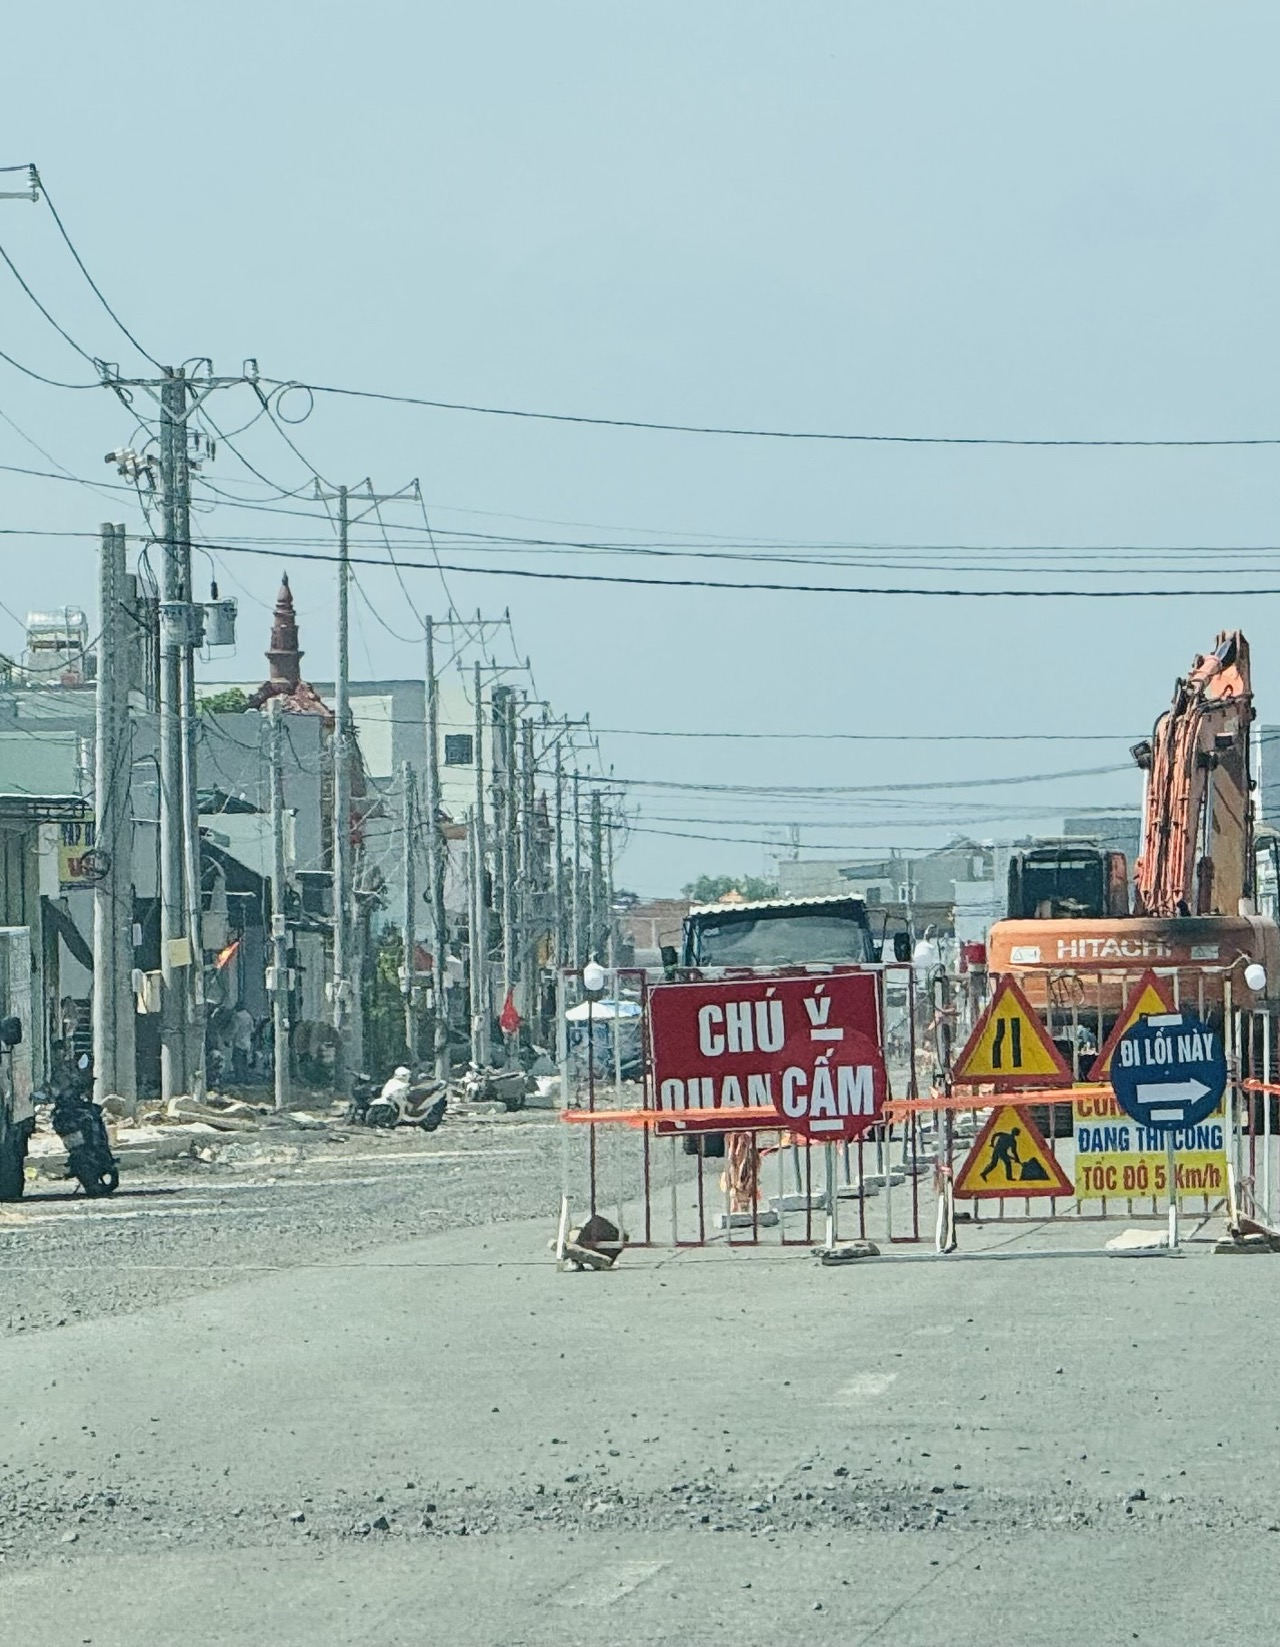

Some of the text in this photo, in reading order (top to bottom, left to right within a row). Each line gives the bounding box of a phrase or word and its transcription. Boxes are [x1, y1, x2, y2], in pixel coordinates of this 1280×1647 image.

[698, 986, 785, 1057] CHÚ
[1119, 1026, 1214, 1068] ĐI LỐI NÀY
[660, 1073, 774, 1128] QUAN
[781, 1047, 875, 1118] CẤM
[1078, 1126, 1130, 1153] ĐANG
[1136, 1127, 1165, 1151] THI
[1083, 1157, 1222, 1196] TỐC ĐỘ 5 Km/h
